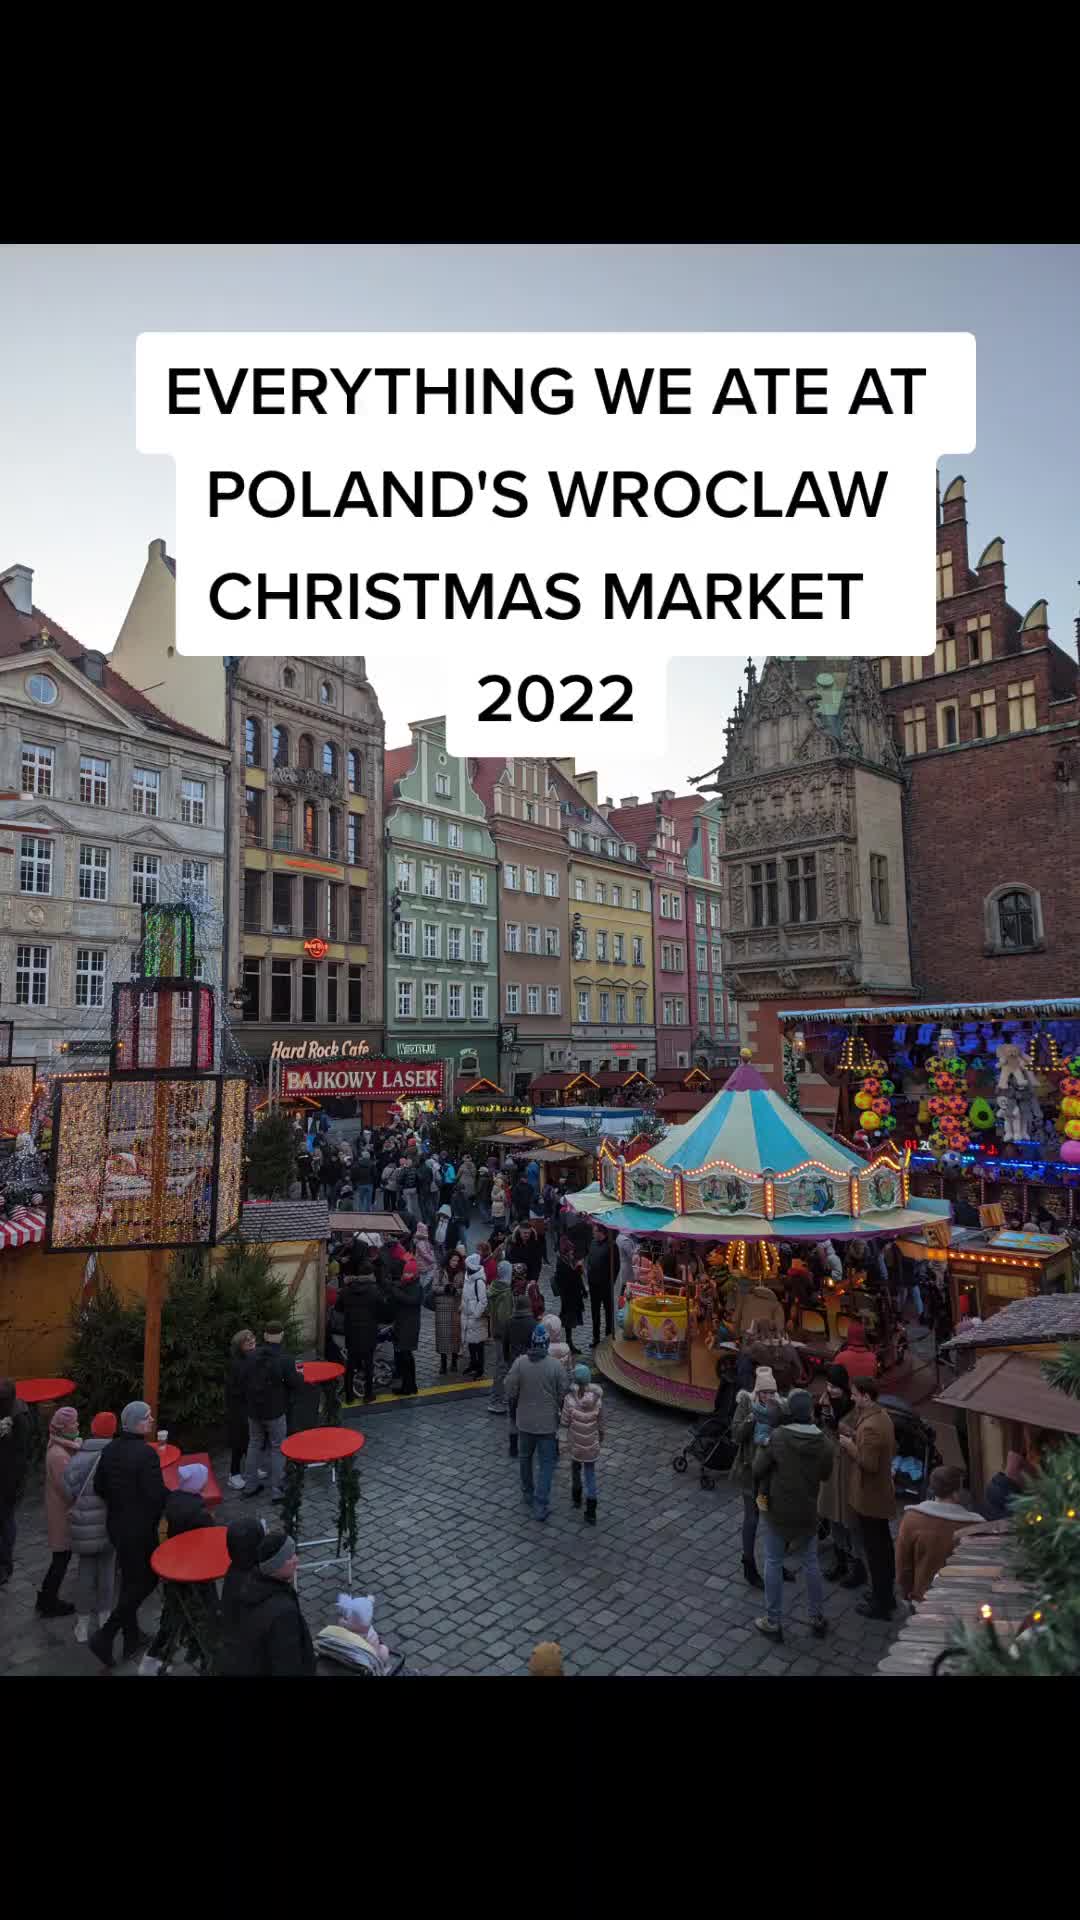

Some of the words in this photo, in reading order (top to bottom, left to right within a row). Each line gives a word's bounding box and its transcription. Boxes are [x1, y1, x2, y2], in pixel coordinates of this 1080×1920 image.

[271, 1040, 308, 1060] Hard
[307, 1039, 340, 1059] Rock
[341, 1039, 370, 1057] Cafe
[287, 1071, 377, 1090] BAJKOWY
[382, 1070, 439, 1088] LASEK
